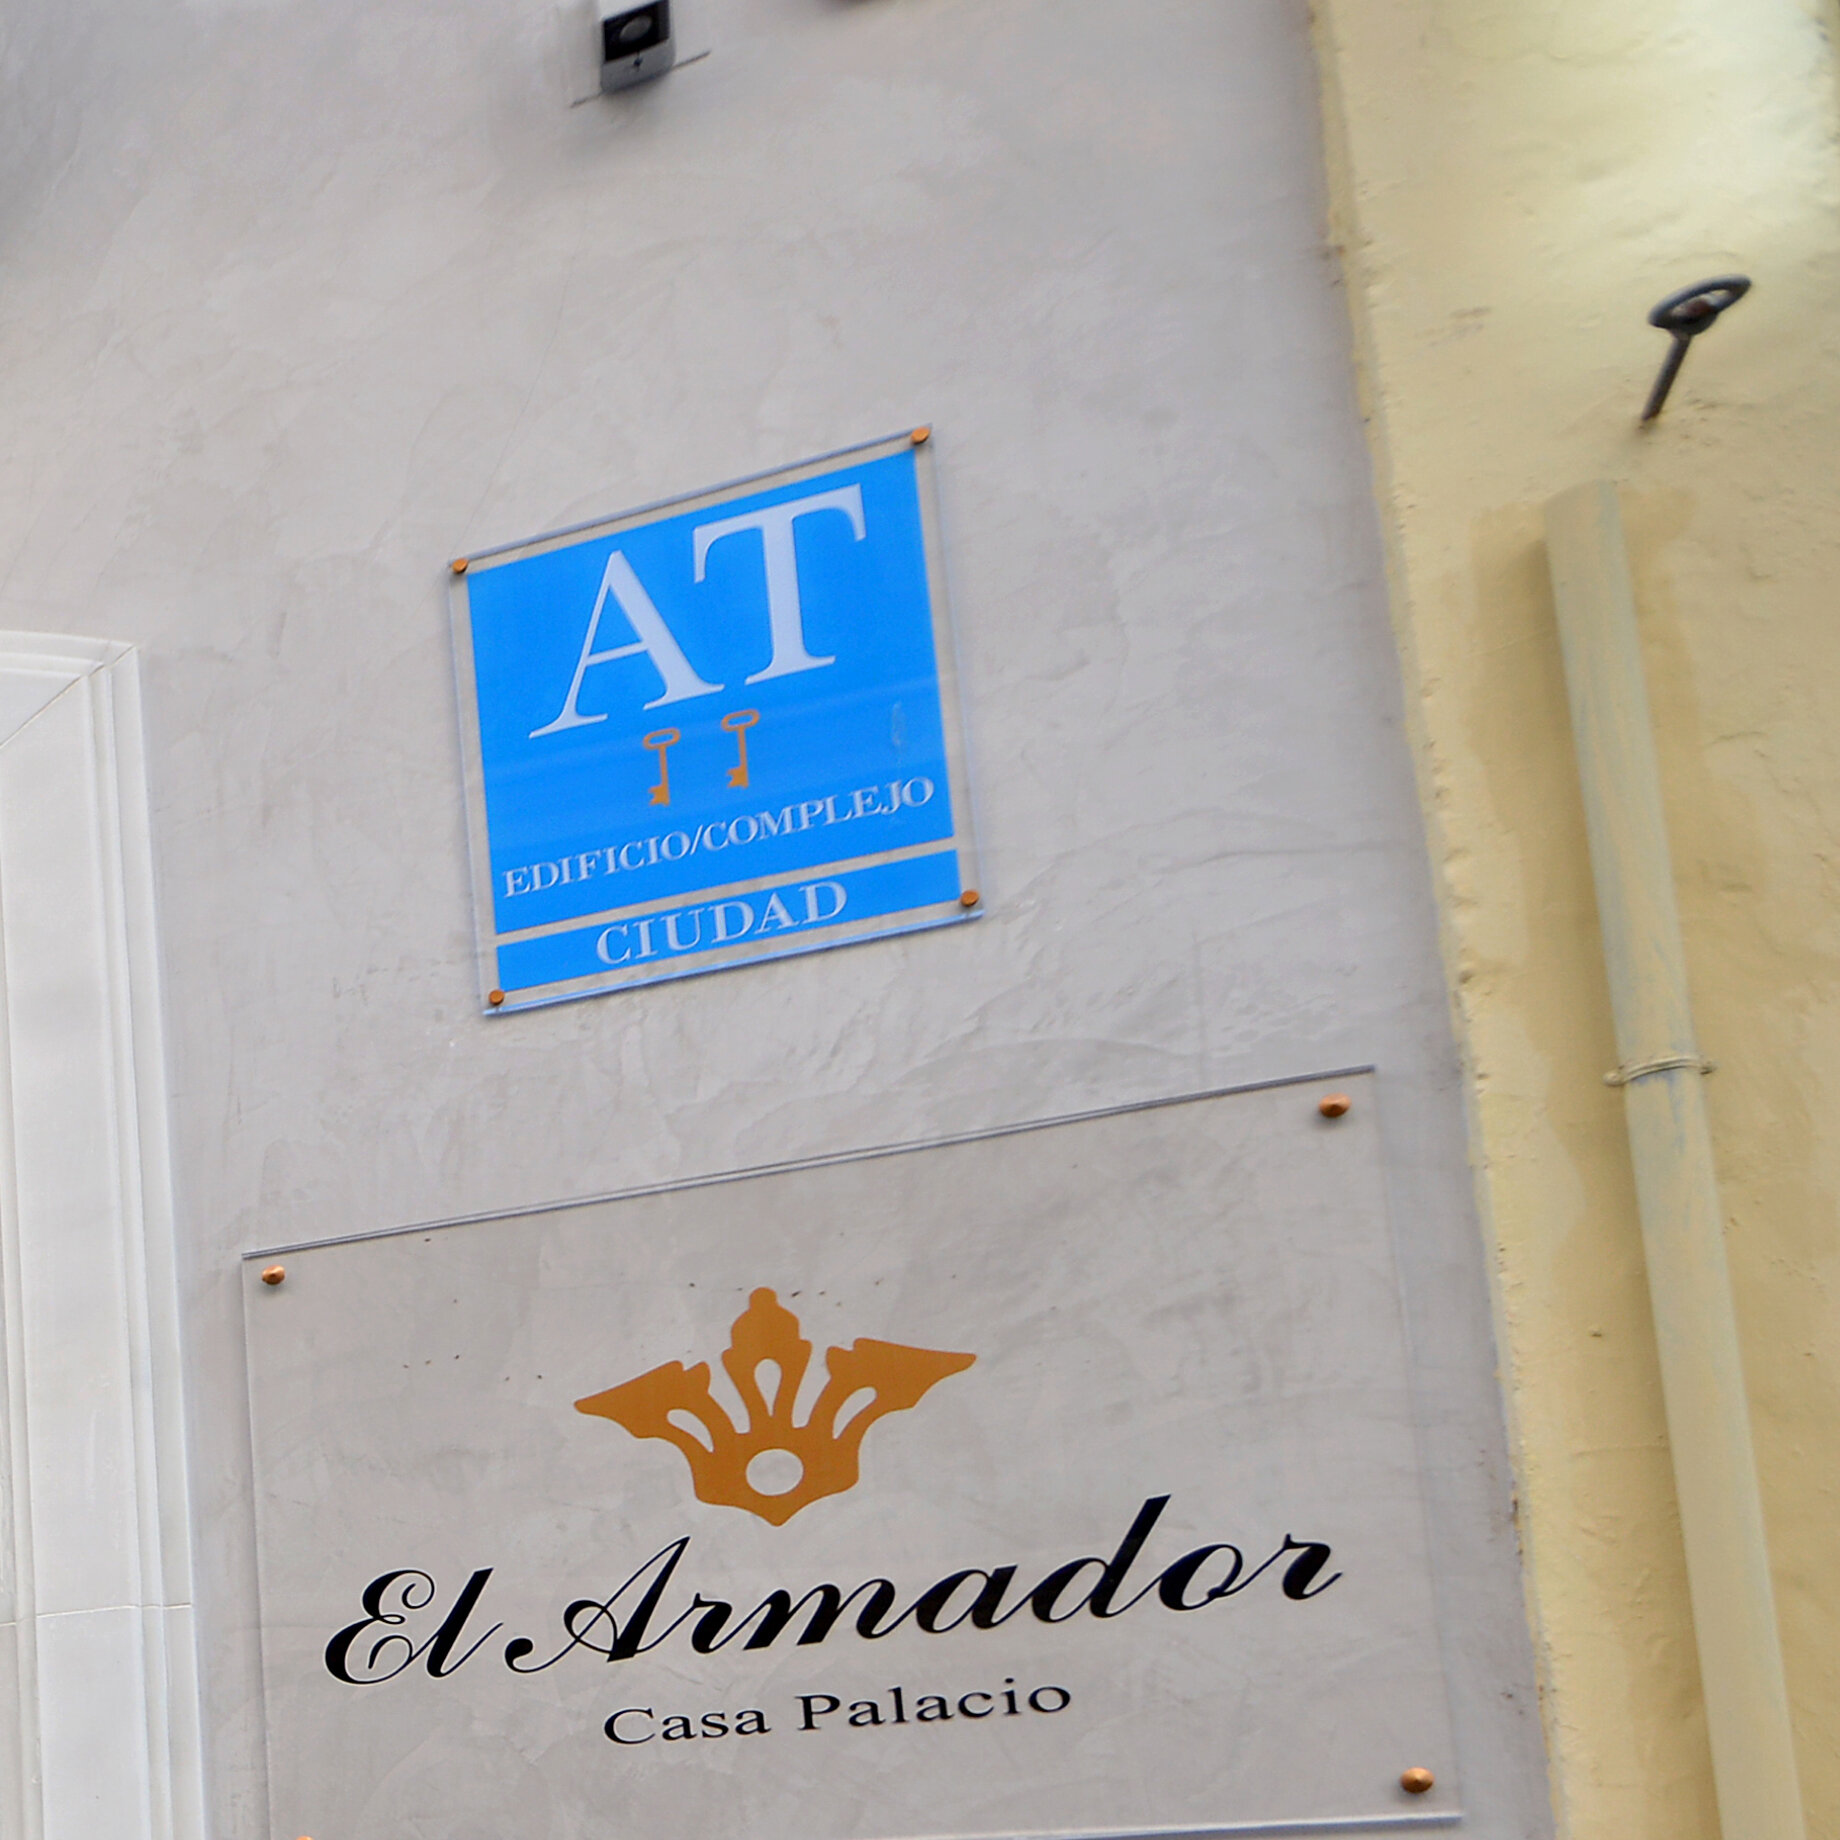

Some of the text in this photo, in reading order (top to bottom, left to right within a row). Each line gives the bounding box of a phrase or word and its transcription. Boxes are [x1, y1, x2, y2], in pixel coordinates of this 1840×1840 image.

[529, 483, 867, 739] AT
[503, 776, 936, 898] EDIFICIO/COMPLEJO
[595, 881, 848, 965] CIUDAD
[324, 1494, 1345, 1688] El Armador
[603, 1677, 1072, 1747] Casa Palacio
